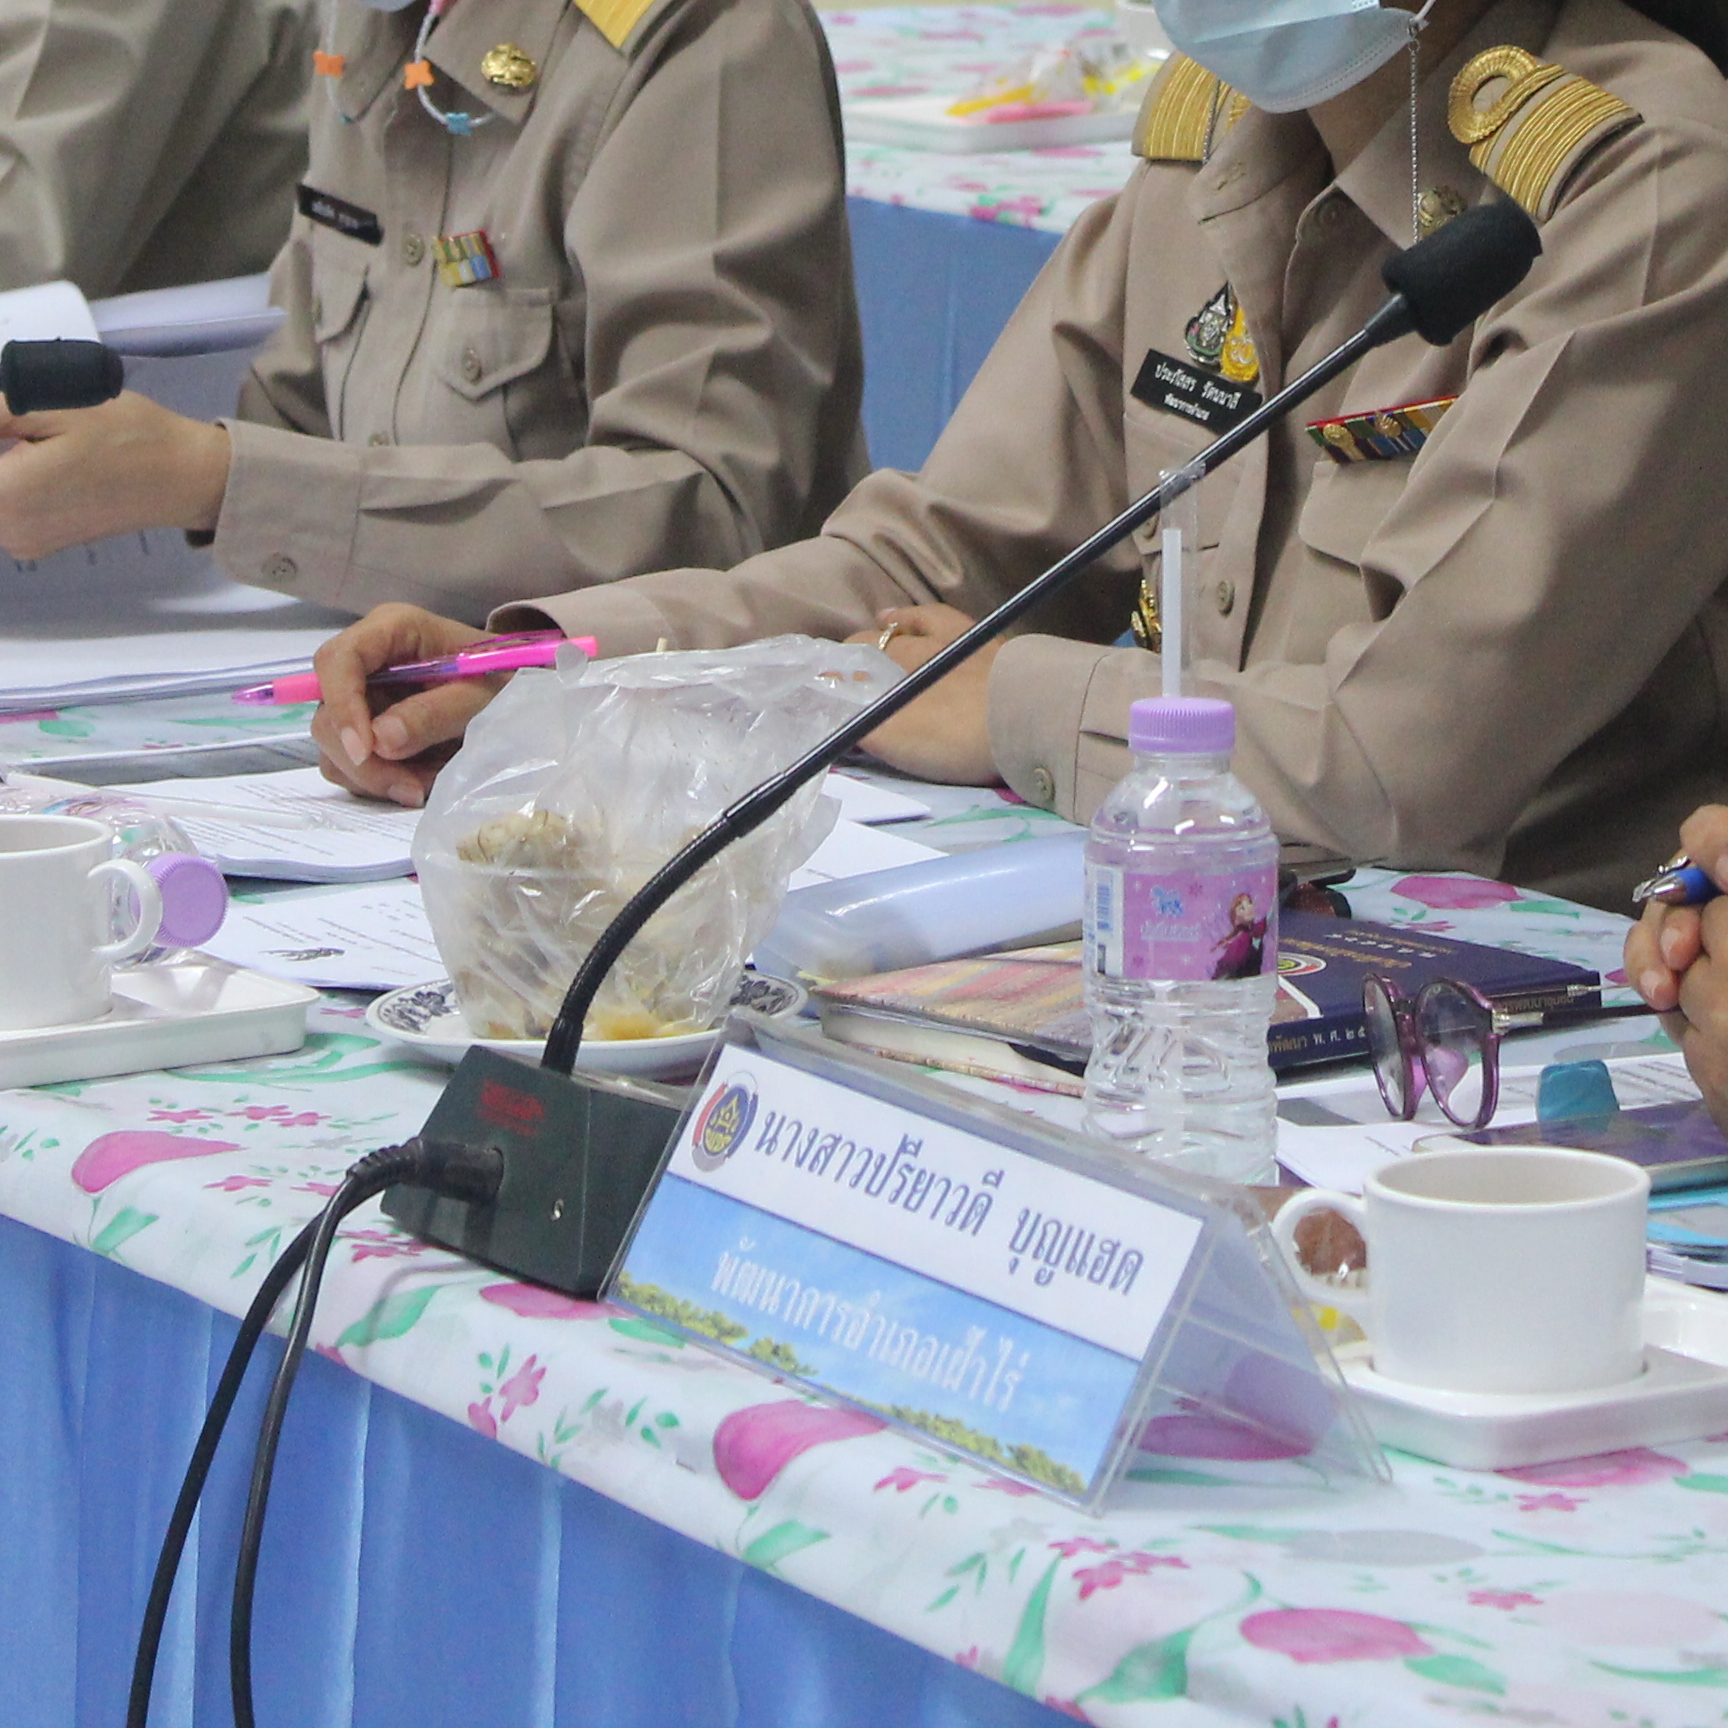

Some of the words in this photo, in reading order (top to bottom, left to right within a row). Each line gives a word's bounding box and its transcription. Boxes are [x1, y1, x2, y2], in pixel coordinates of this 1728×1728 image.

[754, 1110, 1006, 1237] นางสาวปรียาวดี
